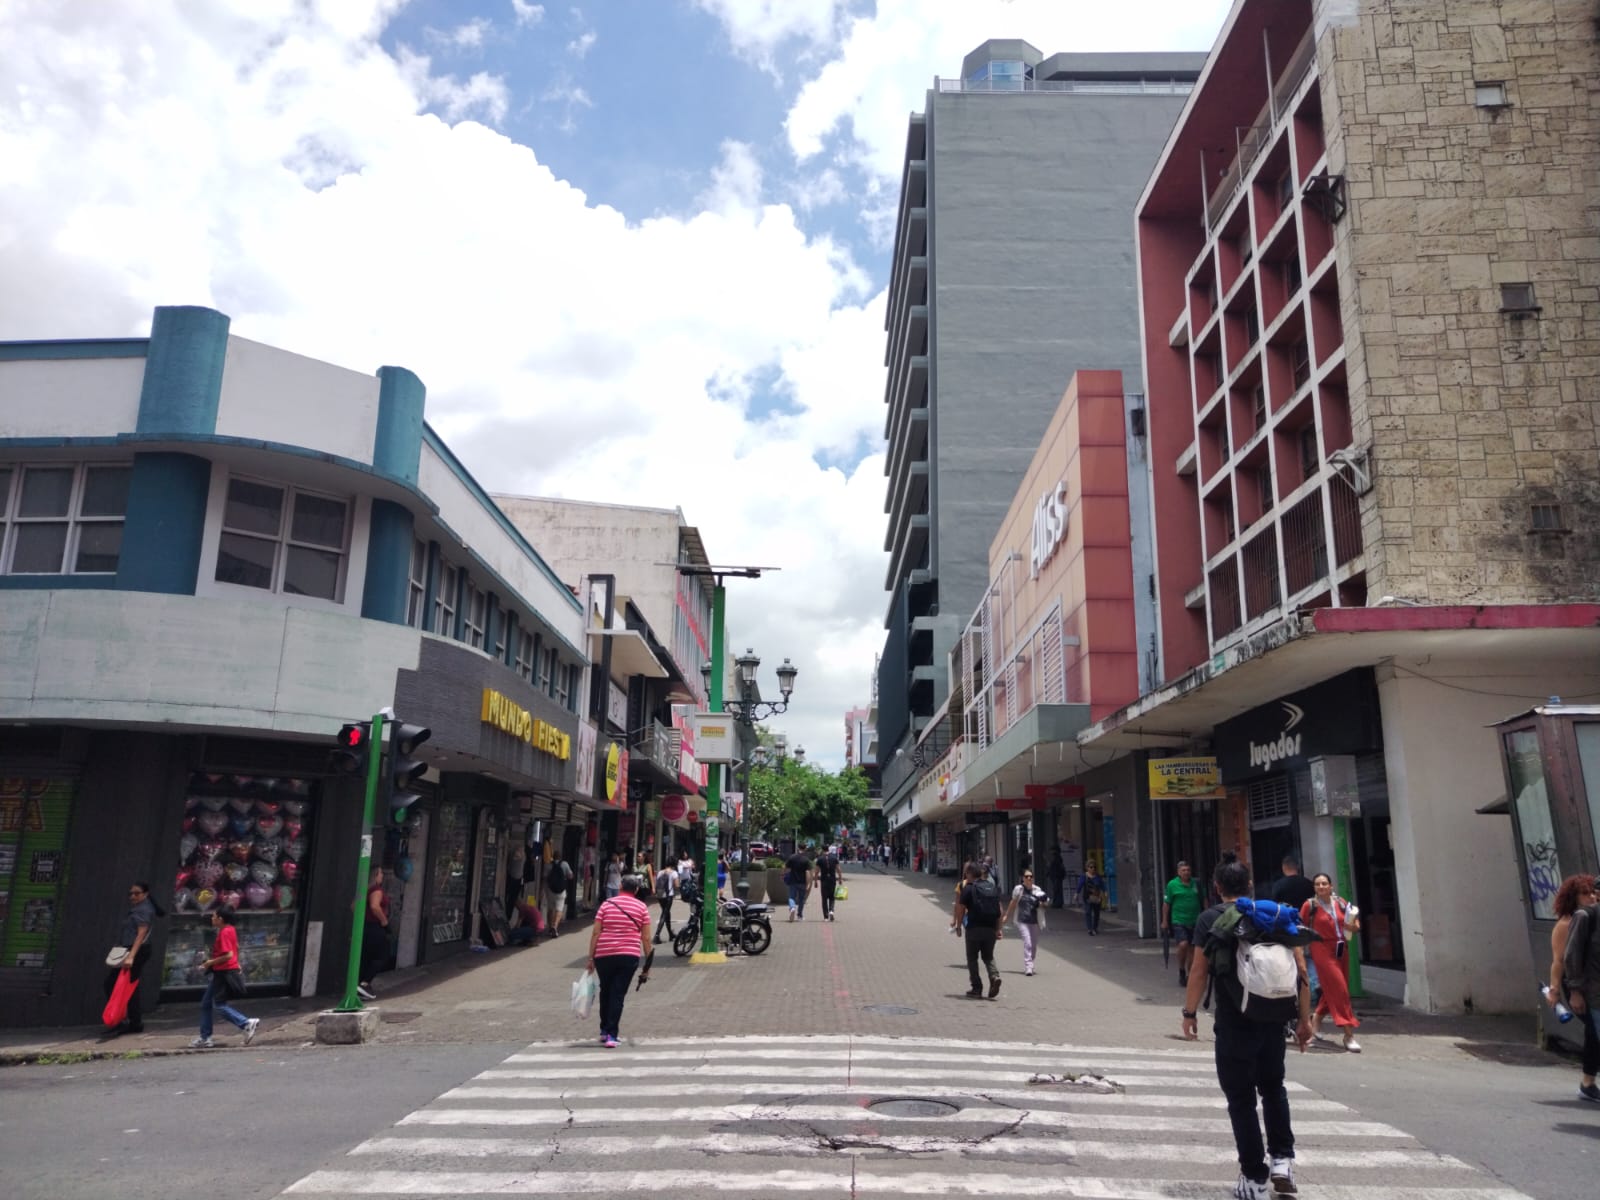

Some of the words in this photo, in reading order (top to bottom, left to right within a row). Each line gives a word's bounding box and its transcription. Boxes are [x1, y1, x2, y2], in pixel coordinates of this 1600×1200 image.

[1031, 480, 1068, 581] Aliss
[482, 687, 532, 742] MUNDO
[1161, 768, 1171, 776] LA
[1174, 767, 1212, 775] CENTRAL
